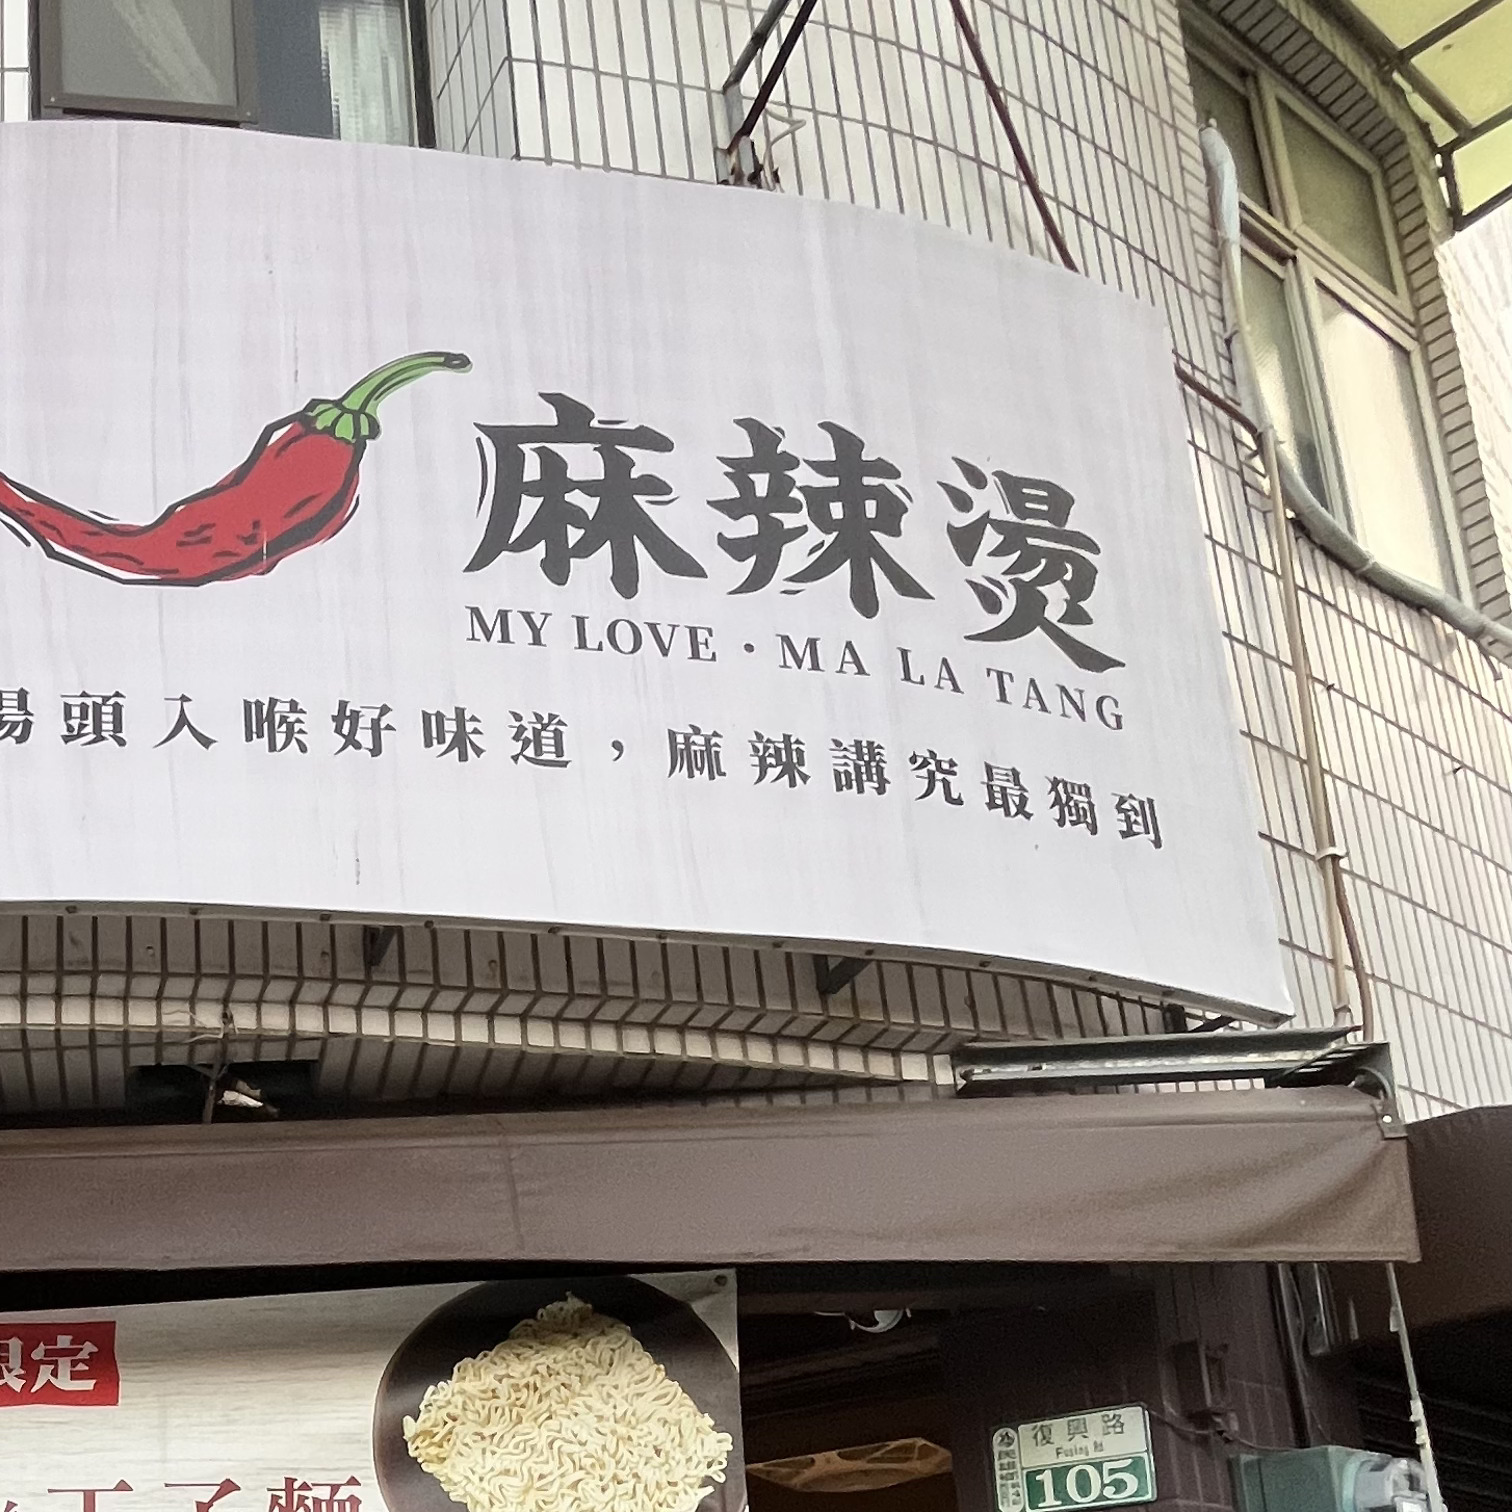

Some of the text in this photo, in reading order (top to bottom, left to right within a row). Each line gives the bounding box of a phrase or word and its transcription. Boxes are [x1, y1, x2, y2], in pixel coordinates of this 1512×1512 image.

[463, 393, 1126, 674] 麻辣燙
[466, 606, 1126, 732] MY LOVE MA LA TANG
[1032, 1413, 1125, 1447] 復興路
[1035, 1459, 1138, 1508] 105
